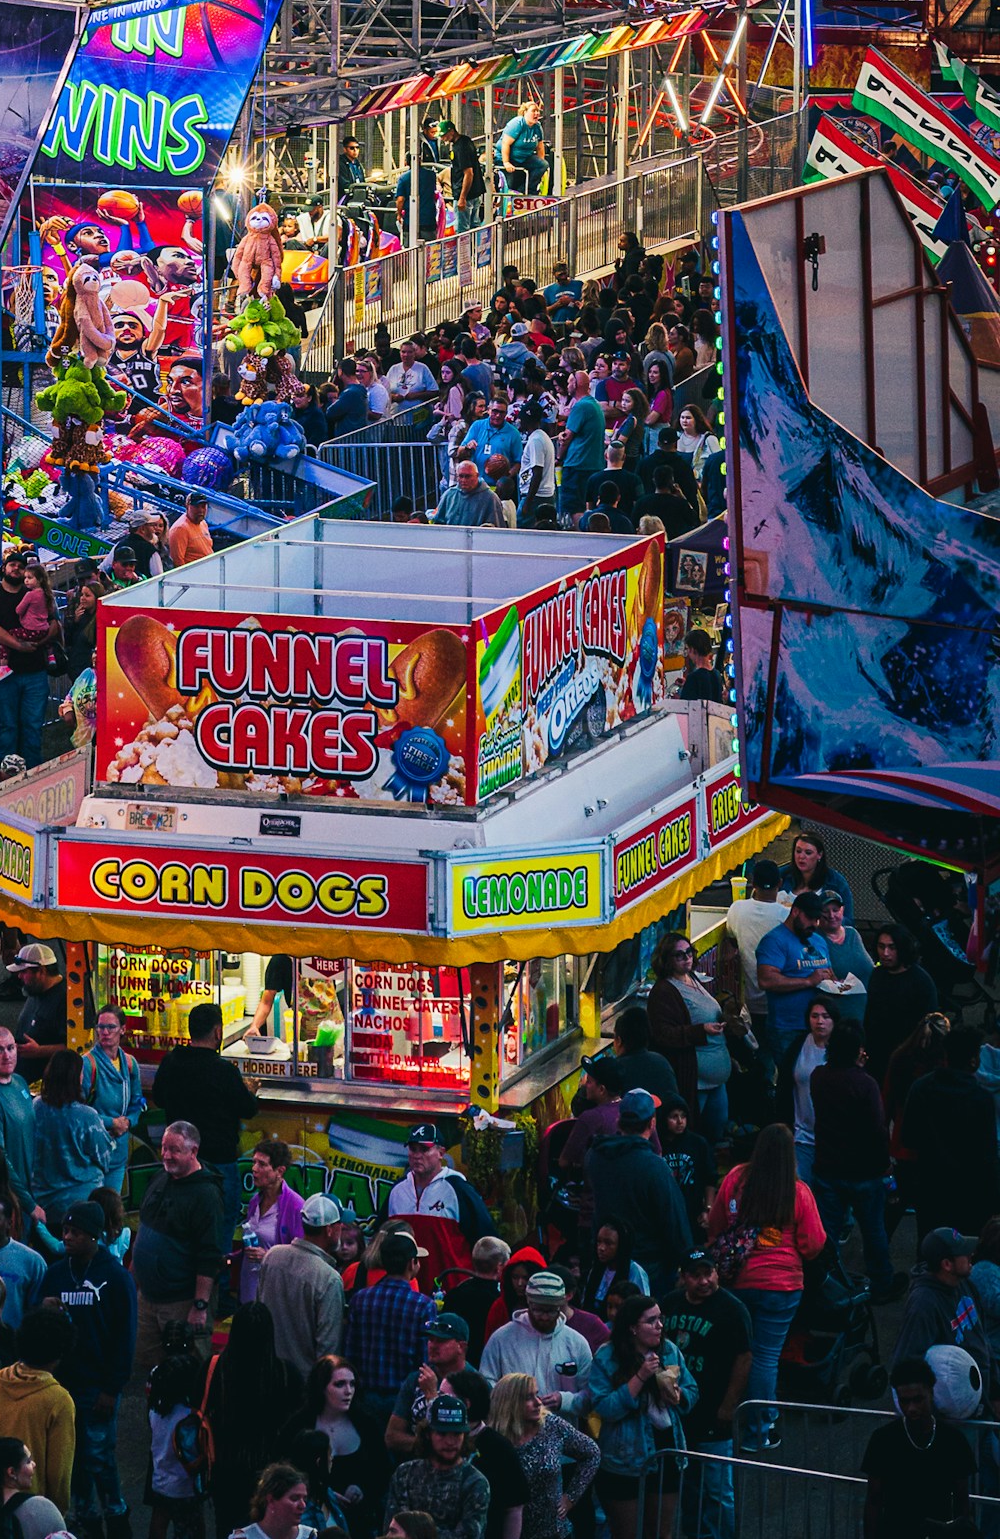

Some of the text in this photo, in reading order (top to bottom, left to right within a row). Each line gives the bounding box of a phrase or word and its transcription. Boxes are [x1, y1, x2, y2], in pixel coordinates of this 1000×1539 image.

[113, 6, 126, 18] IN
[41, 80, 209, 177] WINS
[46, 527, 93, 558] ONE
[522, 567, 628, 719] FUNNEL CAKES
[176, 624, 399, 708] FUNNEL
[550, 666, 600, 742] OREOS
[194, 701, 379, 781] CAKES
[404, 752, 432, 772] PLACE
[408, 745, 435, 763] FIRST
[478, 743, 522, 800] LEMONADE
[711, 780, 742, 836] FRIED
[616, 810, 691, 898] FUNNEL CAKES
[90, 856, 391, 920] CORN DOGS
[461, 865, 589, 919] LEMONADE
[110, 955, 189, 975] CORN DOGS
[316, 960, 340, 972] HERE
[110, 976, 212, 997] FUNNEL CAKES
[354, 973, 435, 993] CORN DOGS
[110, 994, 167, 1013] NACHOS
[354, 993, 460, 1016] FUNNEL CAKES
[354, 1013, 411, 1032] NACHOS
[250, 1062, 287, 1076] ORDER
[331, 1155, 399, 1183] LEMONADE
[60, 1291, 94, 1306] PUMA
